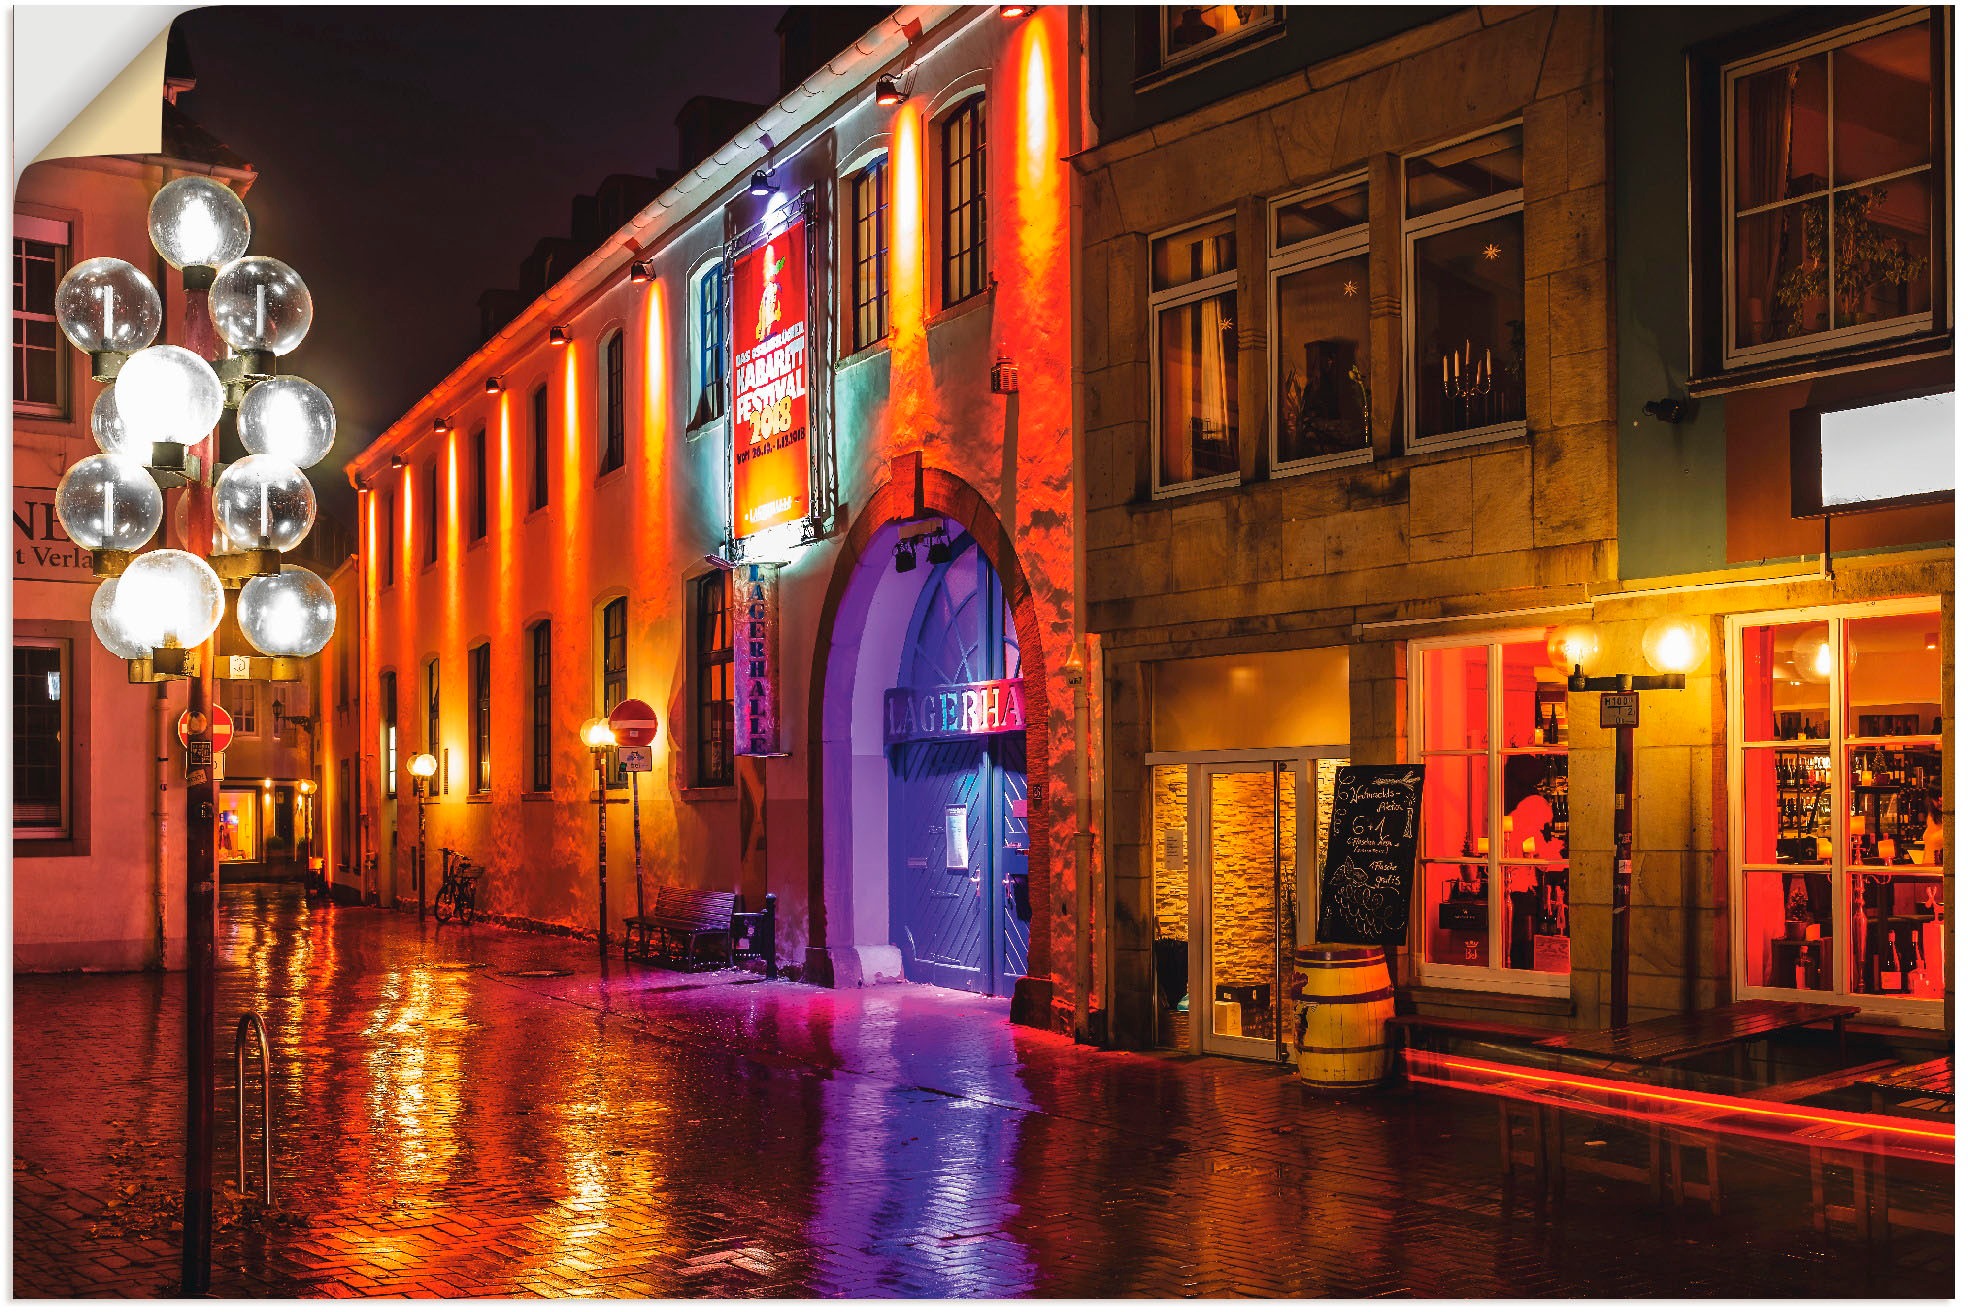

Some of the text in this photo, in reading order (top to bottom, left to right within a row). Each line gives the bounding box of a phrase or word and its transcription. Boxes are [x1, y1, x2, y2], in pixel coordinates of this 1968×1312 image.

[736, 336, 805, 396] KABARETT
[736, 370, 806, 425] FESTIVAL
[749, 395, 792, 445] 2018
[748, 564, 766, 756] LAGERHALLE
[888, 685, 1024, 736] LAGERHA
